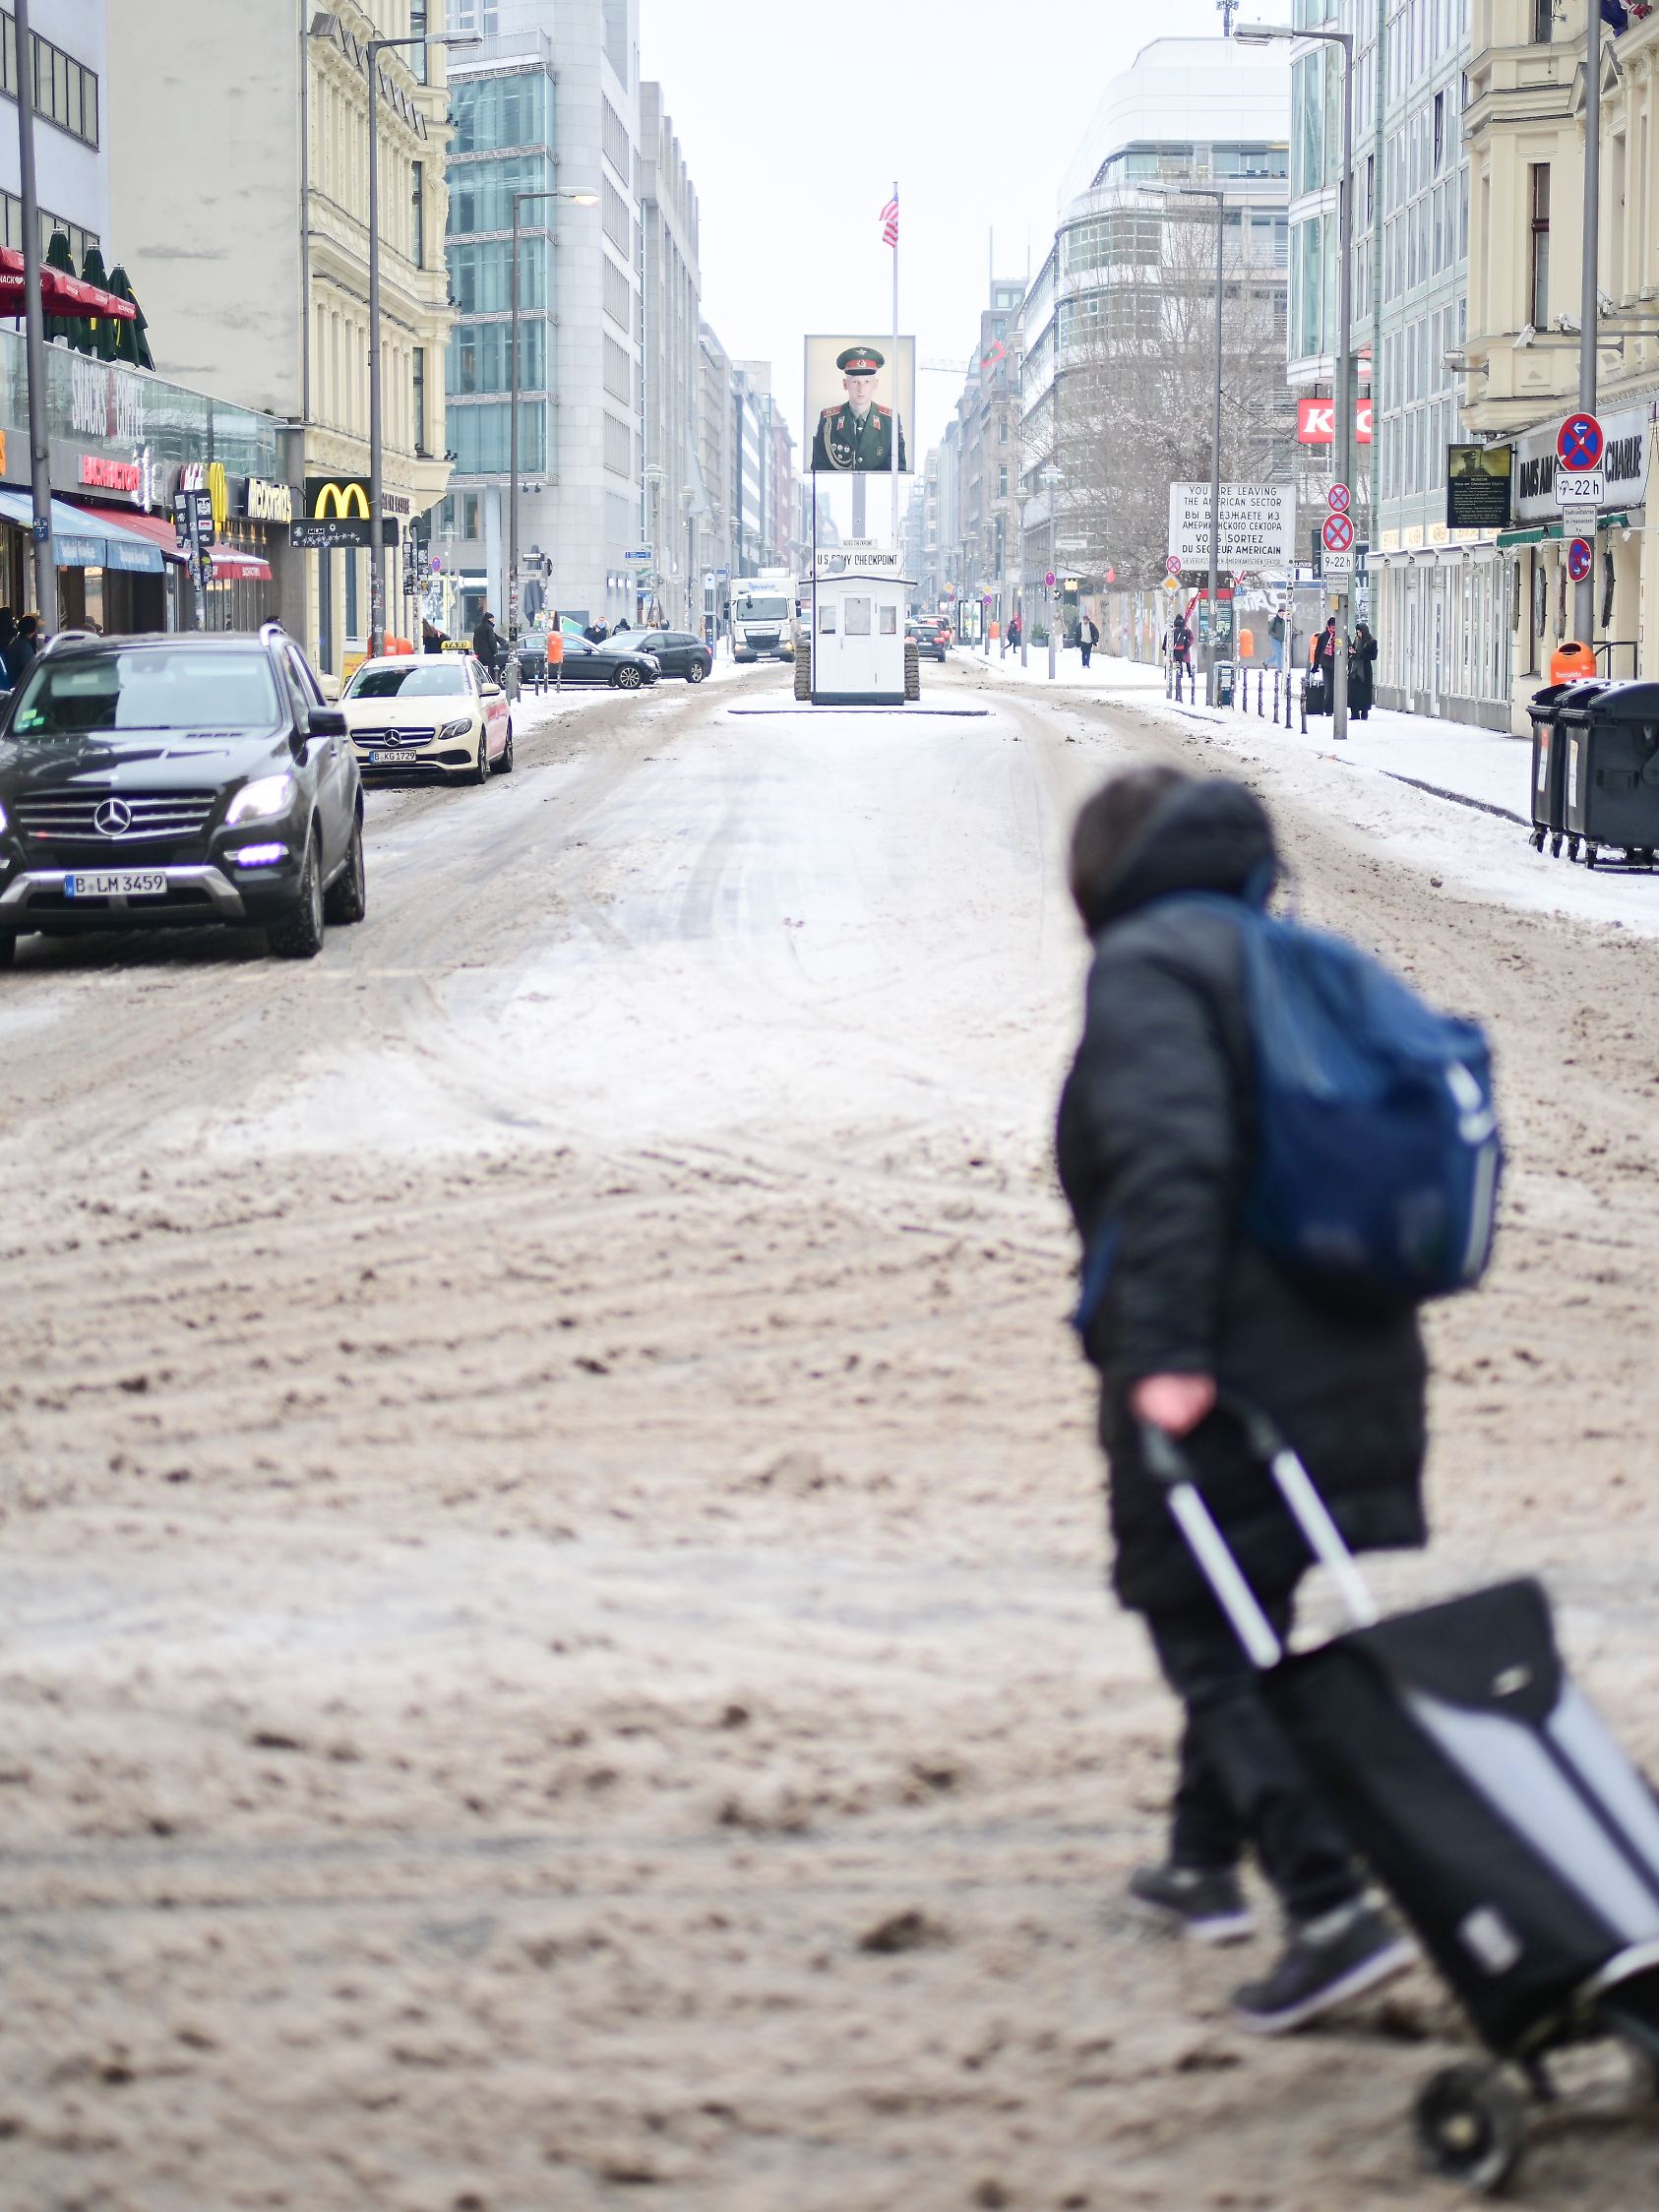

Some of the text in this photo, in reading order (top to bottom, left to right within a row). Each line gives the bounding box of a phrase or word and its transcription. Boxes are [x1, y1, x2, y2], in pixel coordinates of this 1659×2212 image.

[1303, 408, 1372, 433] KC
[1605, 435, 1641, 482] CHARLIE
[1189, 486, 1208, 496] YOU
[1238, 486, 1277, 497] LEAVING
[1593, 479, 1599, 495] h
[1184, 497, 1198, 506] THE
[1251, 498, 1282, 507] SECTOR
[1185, 511, 1280, 521] ВЫ ВЕЗЖАЕТЕ ИЗ
[1249, 522, 1282, 531] СЕКТОРА
[1196, 533, 1263, 544] VOS SORTEZ
[1182, 544, 1281, 556] DU SECEUR AMERICAIN
[817, 555, 823, 565] U
[825, 555, 829, 565] S
[854, 555, 898, 566] CHECKPOINT
[1324, 557, 1345, 568] 9-22
[1346, 557, 1351, 568] h
[75, 875, 163, 892] B LM 3459
